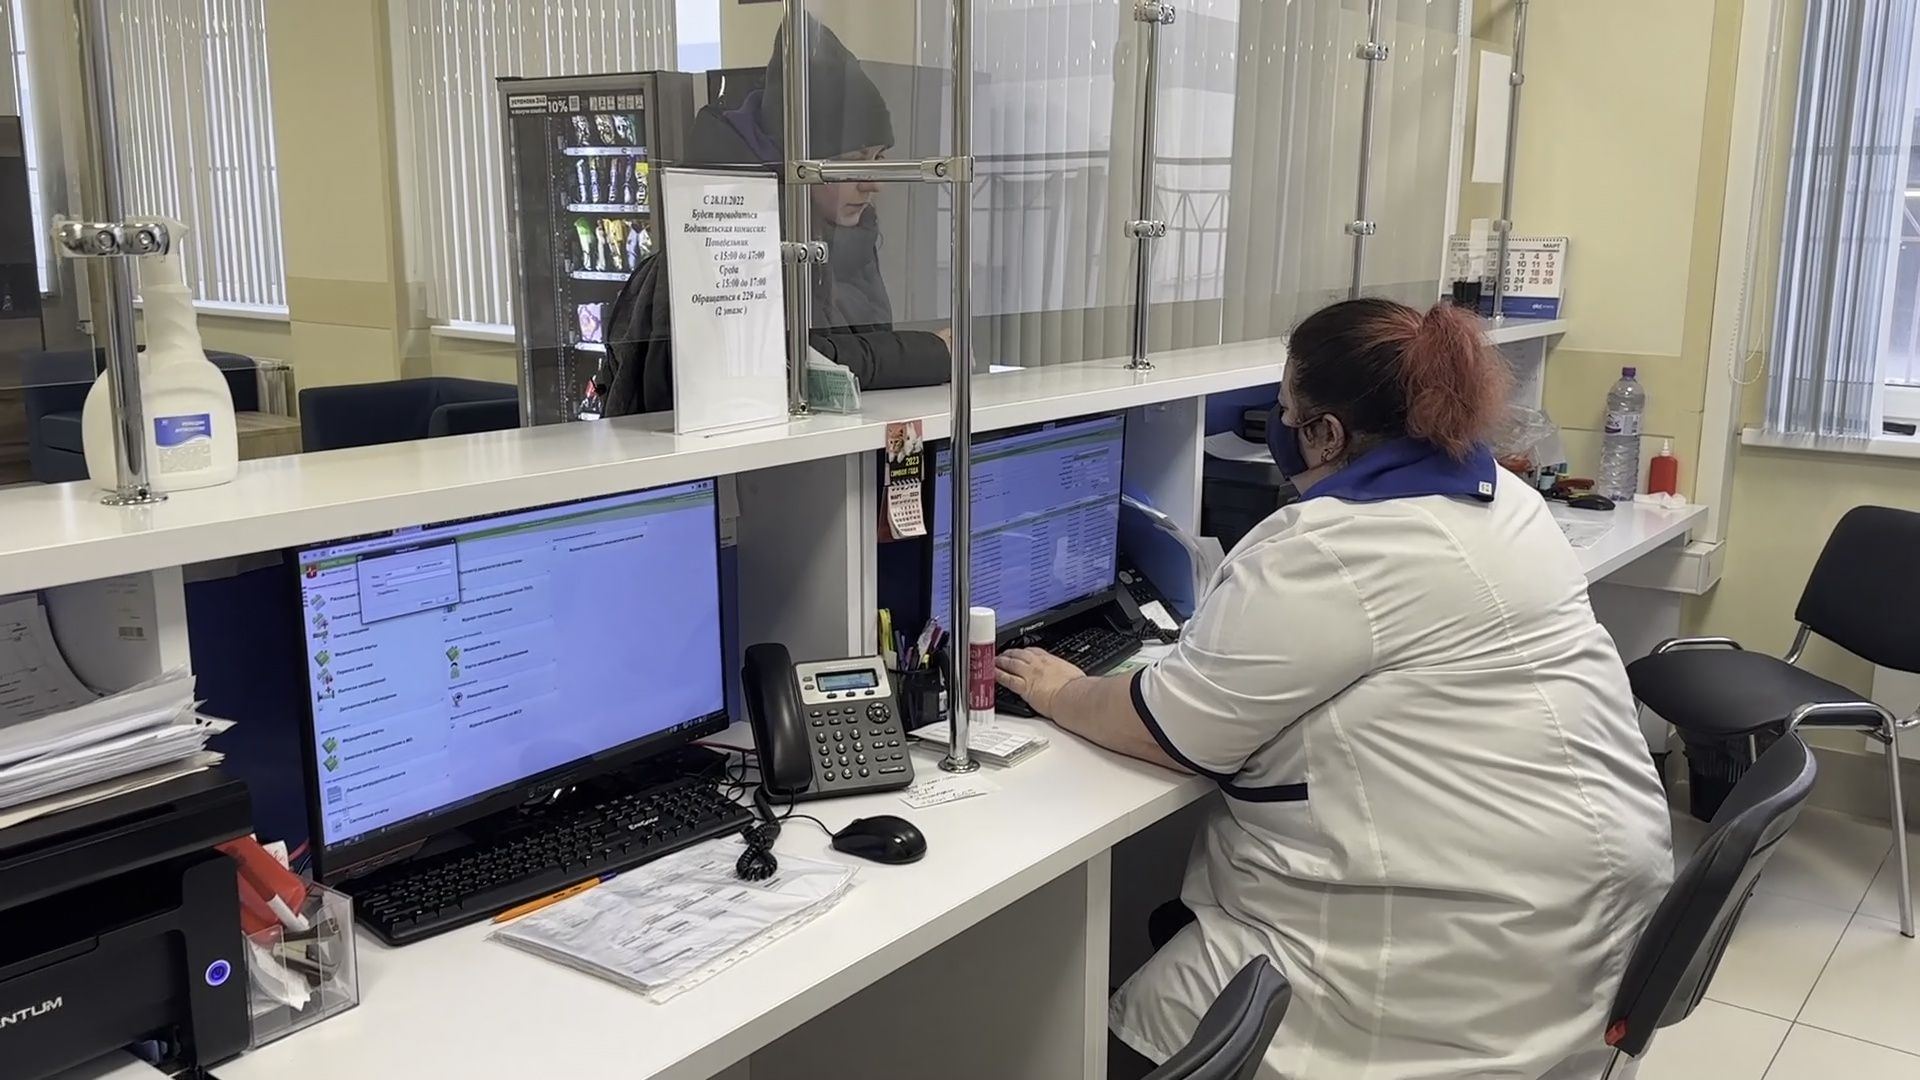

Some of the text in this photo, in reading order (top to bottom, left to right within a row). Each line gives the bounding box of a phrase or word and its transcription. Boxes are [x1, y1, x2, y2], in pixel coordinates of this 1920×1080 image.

[548, 101, 568, 113] 10%
[703, 195, 744, 205] С 28.11.2022
[692, 209, 758, 221] Будет проводиться
[684, 224, 732, 233] Водительская
[705, 237, 749, 247] Понедельник
[720, 252, 738, 261] 15:00
[739, 251, 747, 259] до
[748, 251, 765, 260] 17:00
[719, 265, 739, 276] Среда
[722, 279, 739, 288] 15:00
[740, 278, 748, 287] до
[750, 277, 766, 287] 17:00
[692, 293, 736, 305] Обращаться
[742, 291, 753, 301] 229
[906, 456, 919, 466] 2023
[0, 996, 62, 1028] NTUM
